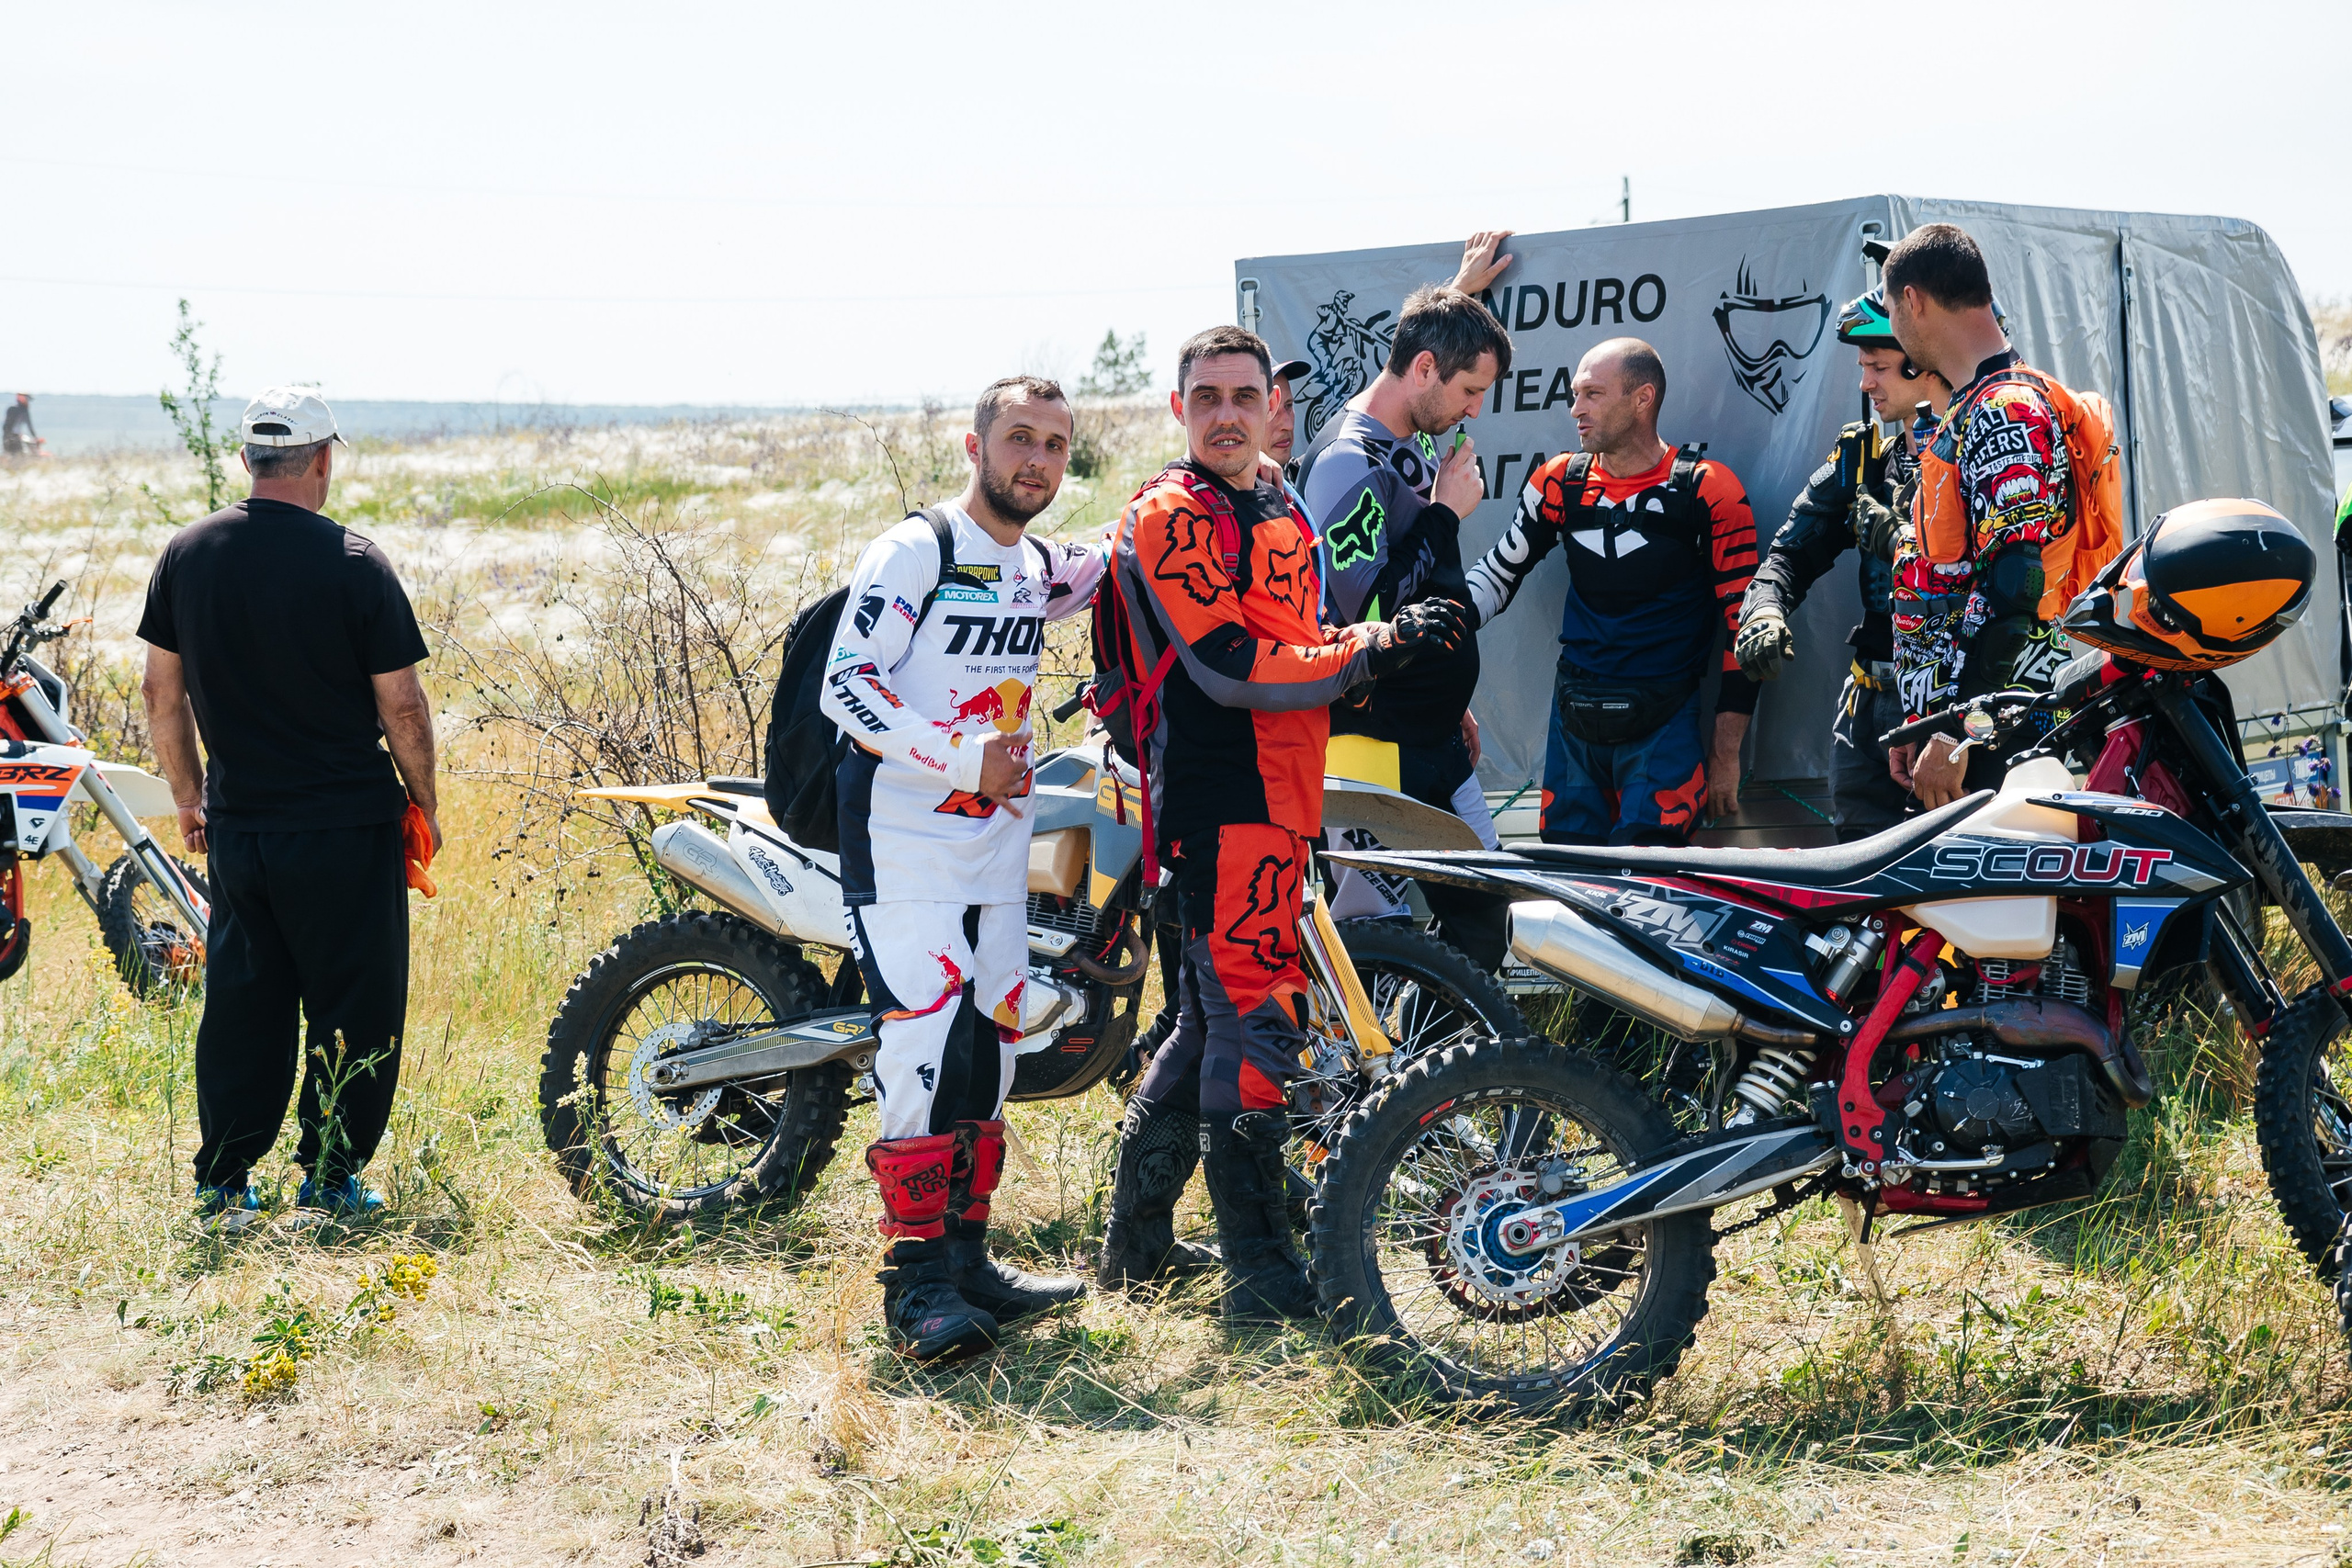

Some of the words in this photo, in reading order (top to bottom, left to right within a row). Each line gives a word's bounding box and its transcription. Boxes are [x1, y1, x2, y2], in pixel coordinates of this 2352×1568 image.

[1477, 273, 1667, 332] NDURO
[1492, 367, 1577, 413] TEA
[944, 591, 996, 602] MOTOREX
[965, 665, 982, 673] THE
[985, 665, 1005, 674] FIRST
[1008, 665, 1021, 674] THE
[2112, 807, 2164, 818] 300
[1929, 845, 2173, 885] SCOUT
[1623, 895, 1720, 942] ZM
[1749, 919, 1773, 933] ZM
